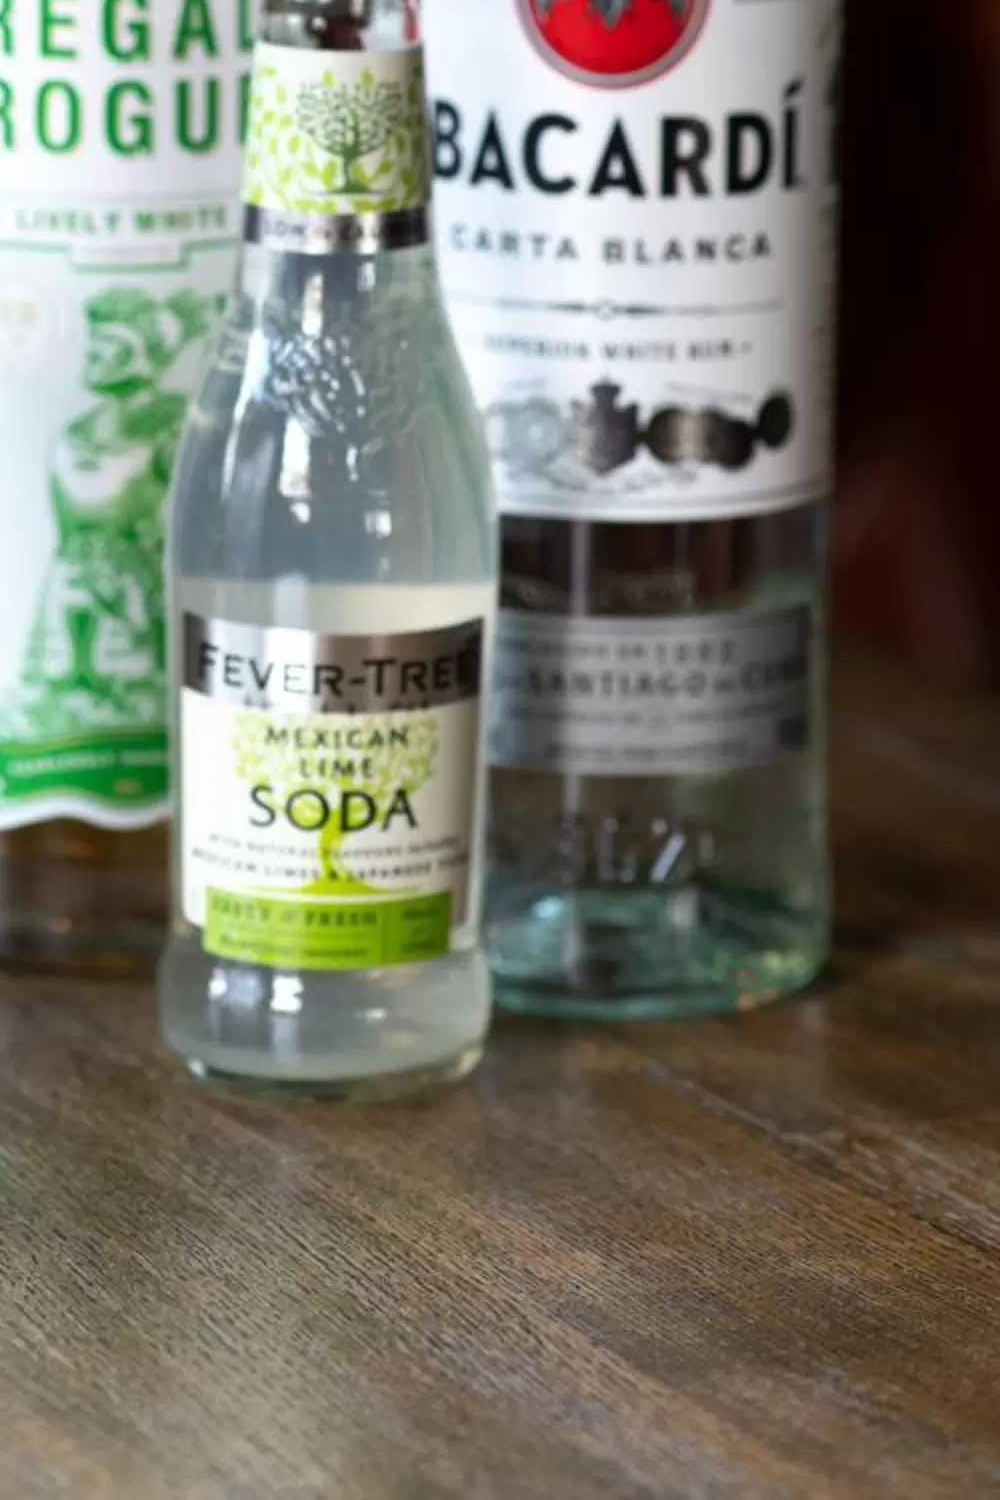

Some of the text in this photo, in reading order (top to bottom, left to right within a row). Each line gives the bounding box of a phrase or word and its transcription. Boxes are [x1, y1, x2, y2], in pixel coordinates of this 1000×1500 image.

[432, 77, 805, 197] BACARDÍ
[14, 204, 226, 233] LIVELY WHITE
[449, 222, 772, 264] CARTA BLANCA
[200, 641, 480, 696] FEVER-TREE
[264, 723, 410, 749] MEXICAN
[300, 757, 376, 780] LIME
[249, 784, 418, 833] SODA
